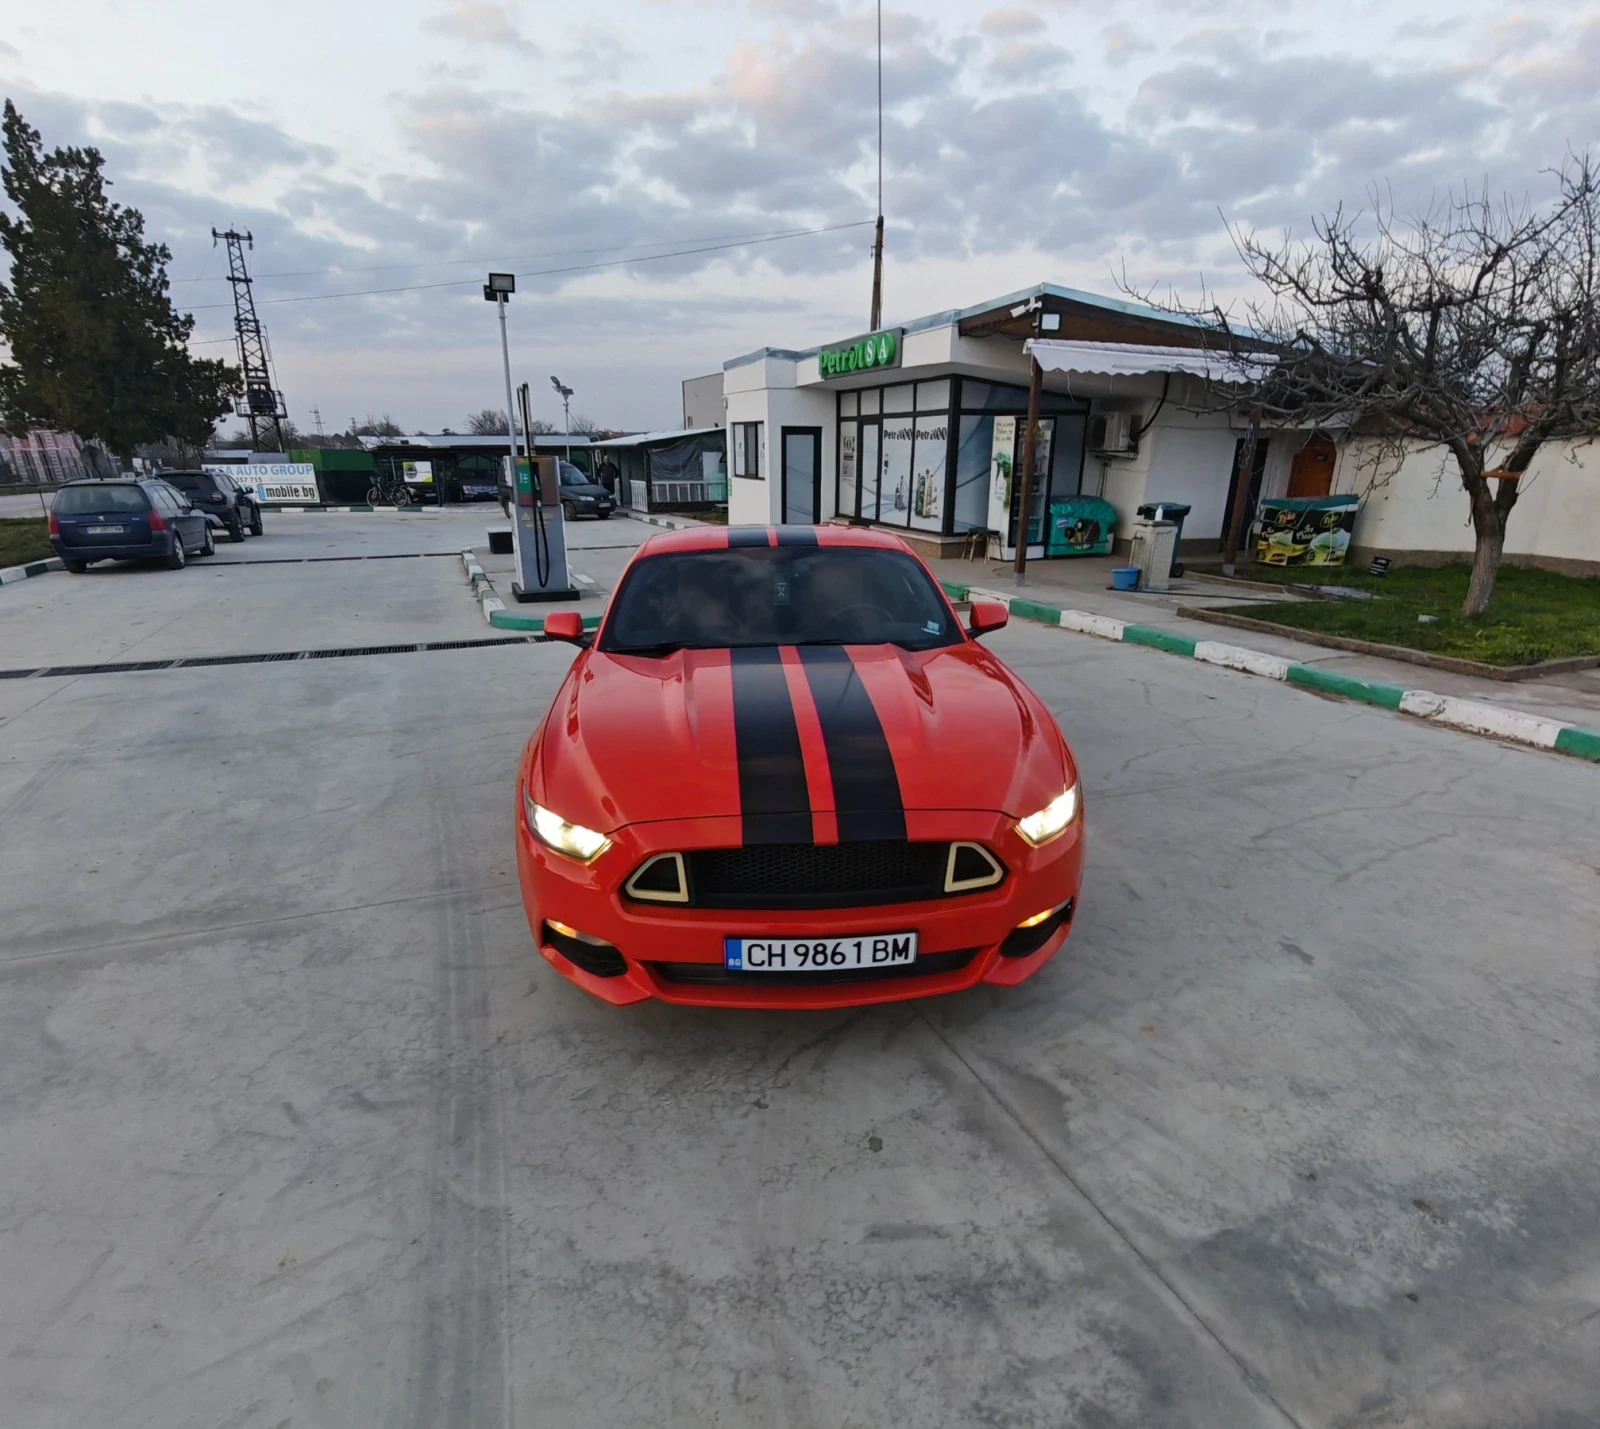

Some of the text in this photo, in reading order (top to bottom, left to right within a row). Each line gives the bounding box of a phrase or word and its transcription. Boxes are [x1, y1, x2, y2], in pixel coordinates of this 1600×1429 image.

[236, 465, 268, 475] AUTO
[270, 465, 313, 475] GROUP
[265, 485, 316, 498] mobile.bg
[747, 936, 911, 968] CH 9861 BM
[728, 958, 741, 966] BG
